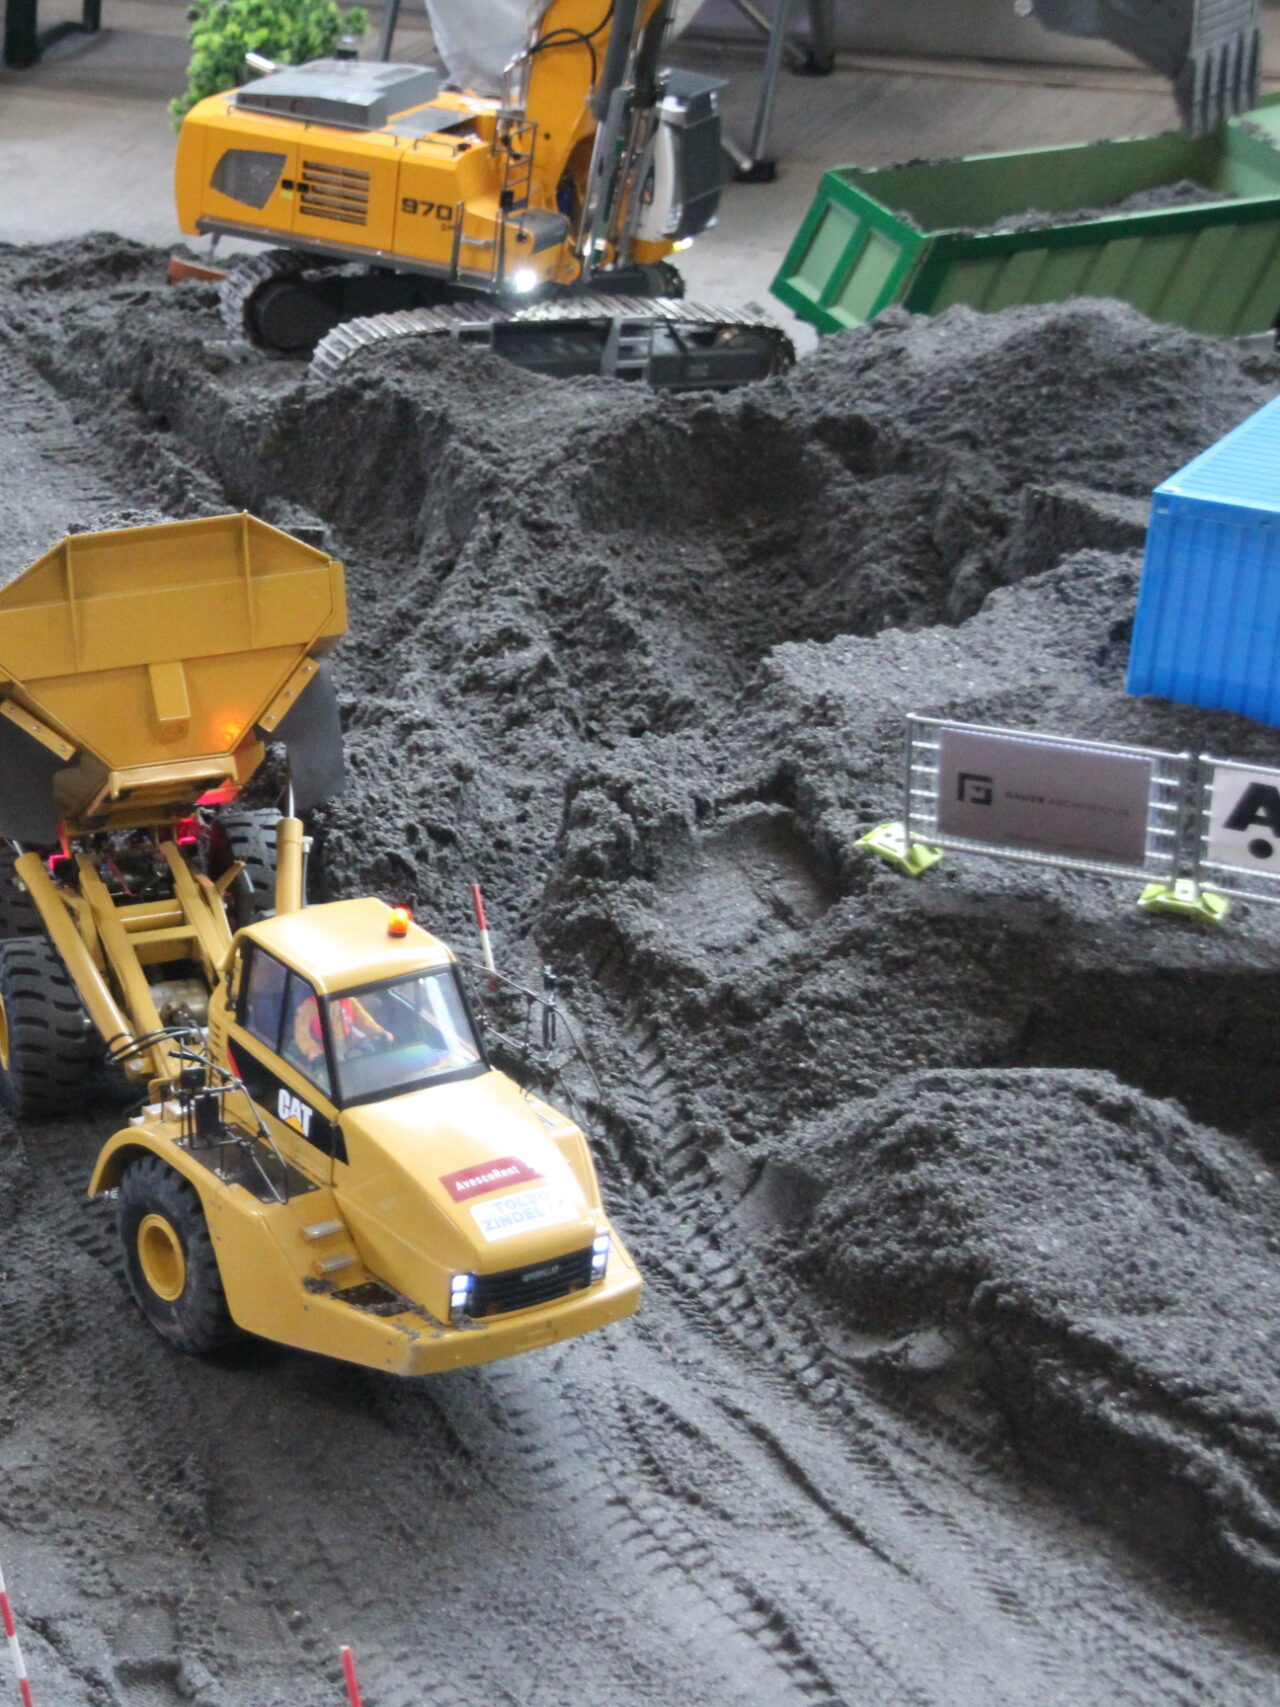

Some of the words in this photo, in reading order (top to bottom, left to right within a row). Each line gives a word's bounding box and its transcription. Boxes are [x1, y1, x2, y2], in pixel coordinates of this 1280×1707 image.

[402, 198, 452, 221] 970
[278, 1088, 313, 1137] CAT
[455, 1165, 521, 1192] AvescoRent
[491, 1191, 550, 1214] TOLDO
